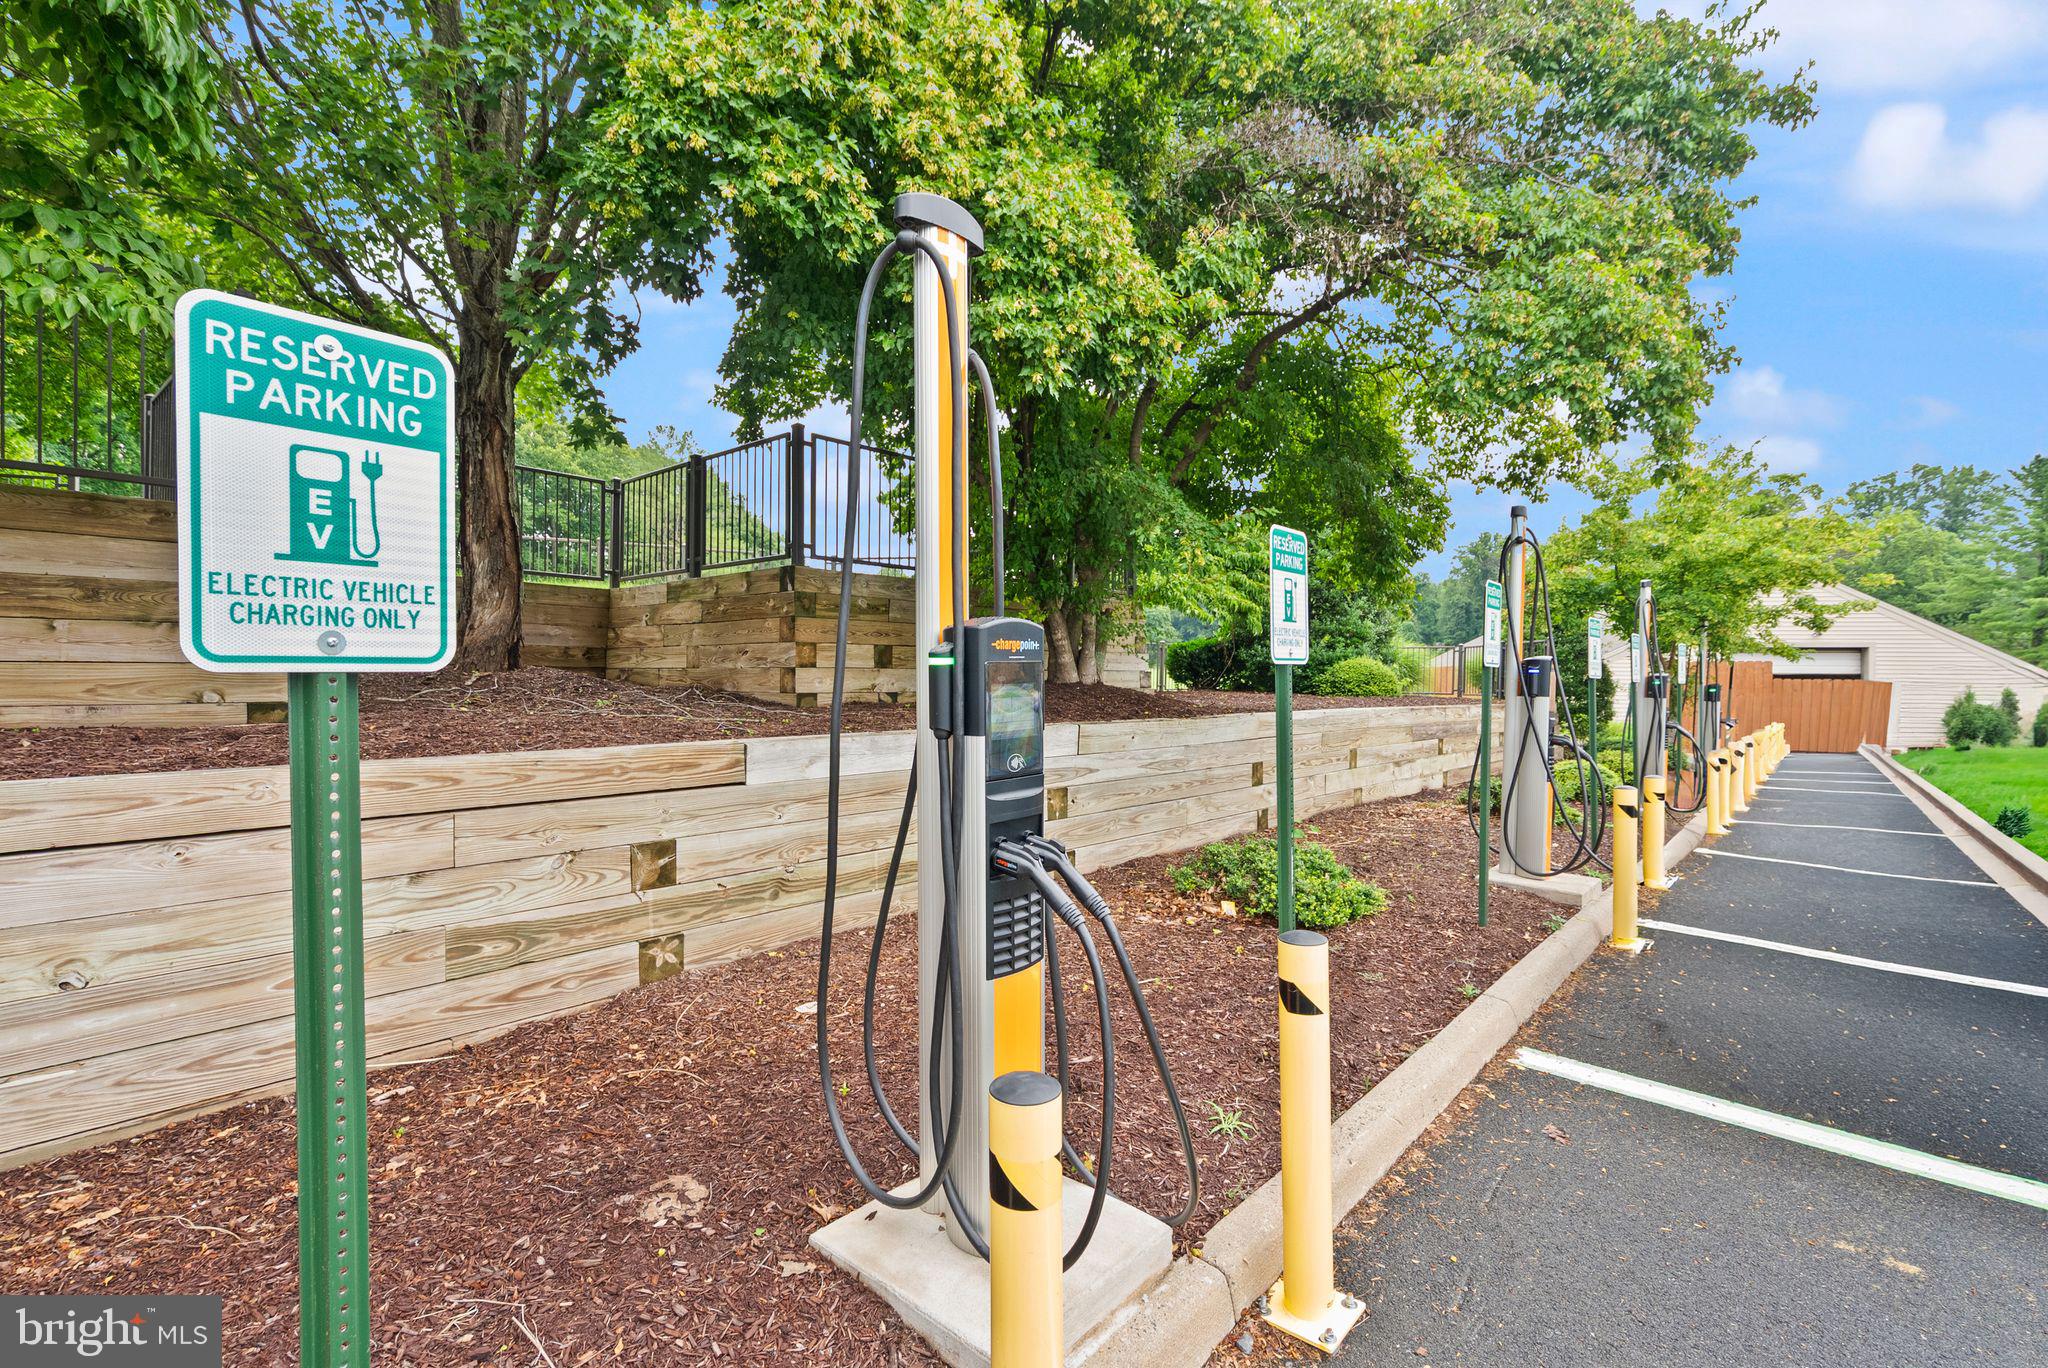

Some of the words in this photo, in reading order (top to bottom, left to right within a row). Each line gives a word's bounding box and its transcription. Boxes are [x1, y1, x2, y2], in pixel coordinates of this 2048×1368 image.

[205, 318, 437, 400] RESERVED
[226, 368, 422, 437] PARKING
[1273, 534, 1305, 556] RESERVED
[1275, 552, 1303, 571] PARKING
[208, 571, 334, 600] ELECTRIC
[343, 580, 436, 605] VEHICLE
[229, 601, 355, 628] CHARGING
[363, 607, 421, 630] ONLY
